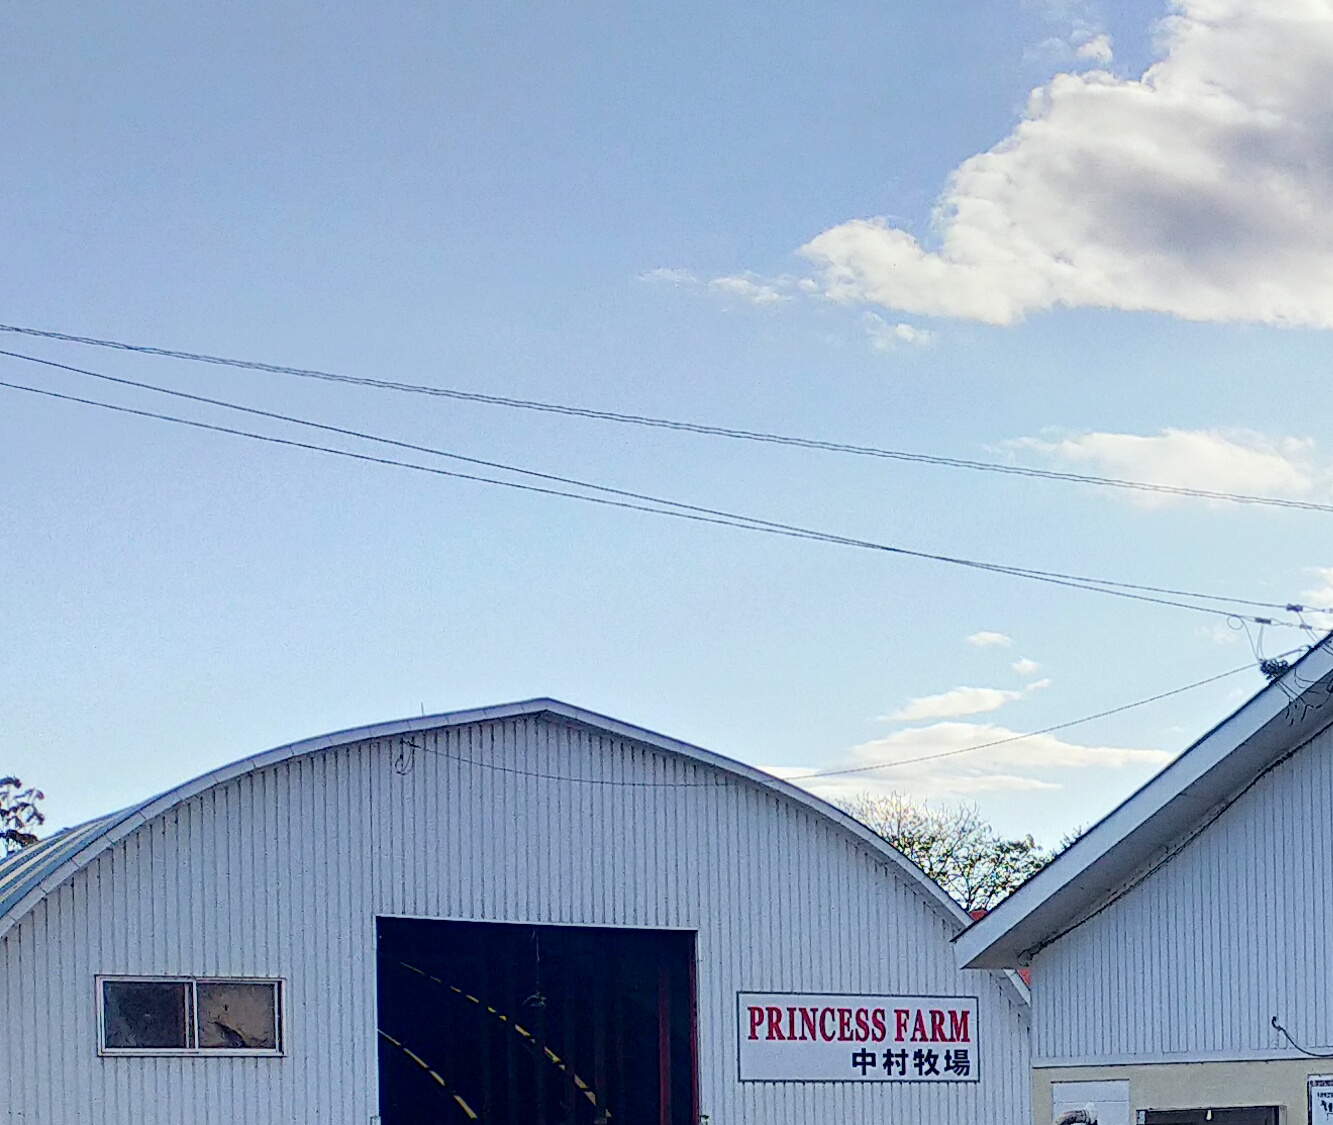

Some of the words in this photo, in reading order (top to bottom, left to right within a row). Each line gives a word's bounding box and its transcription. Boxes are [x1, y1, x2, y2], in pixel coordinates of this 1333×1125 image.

[747, 1006, 887, 1042] PRINCESS
[894, 1009, 971, 1042] FARM
[852, 1048, 971, 1077] 中村牧場
